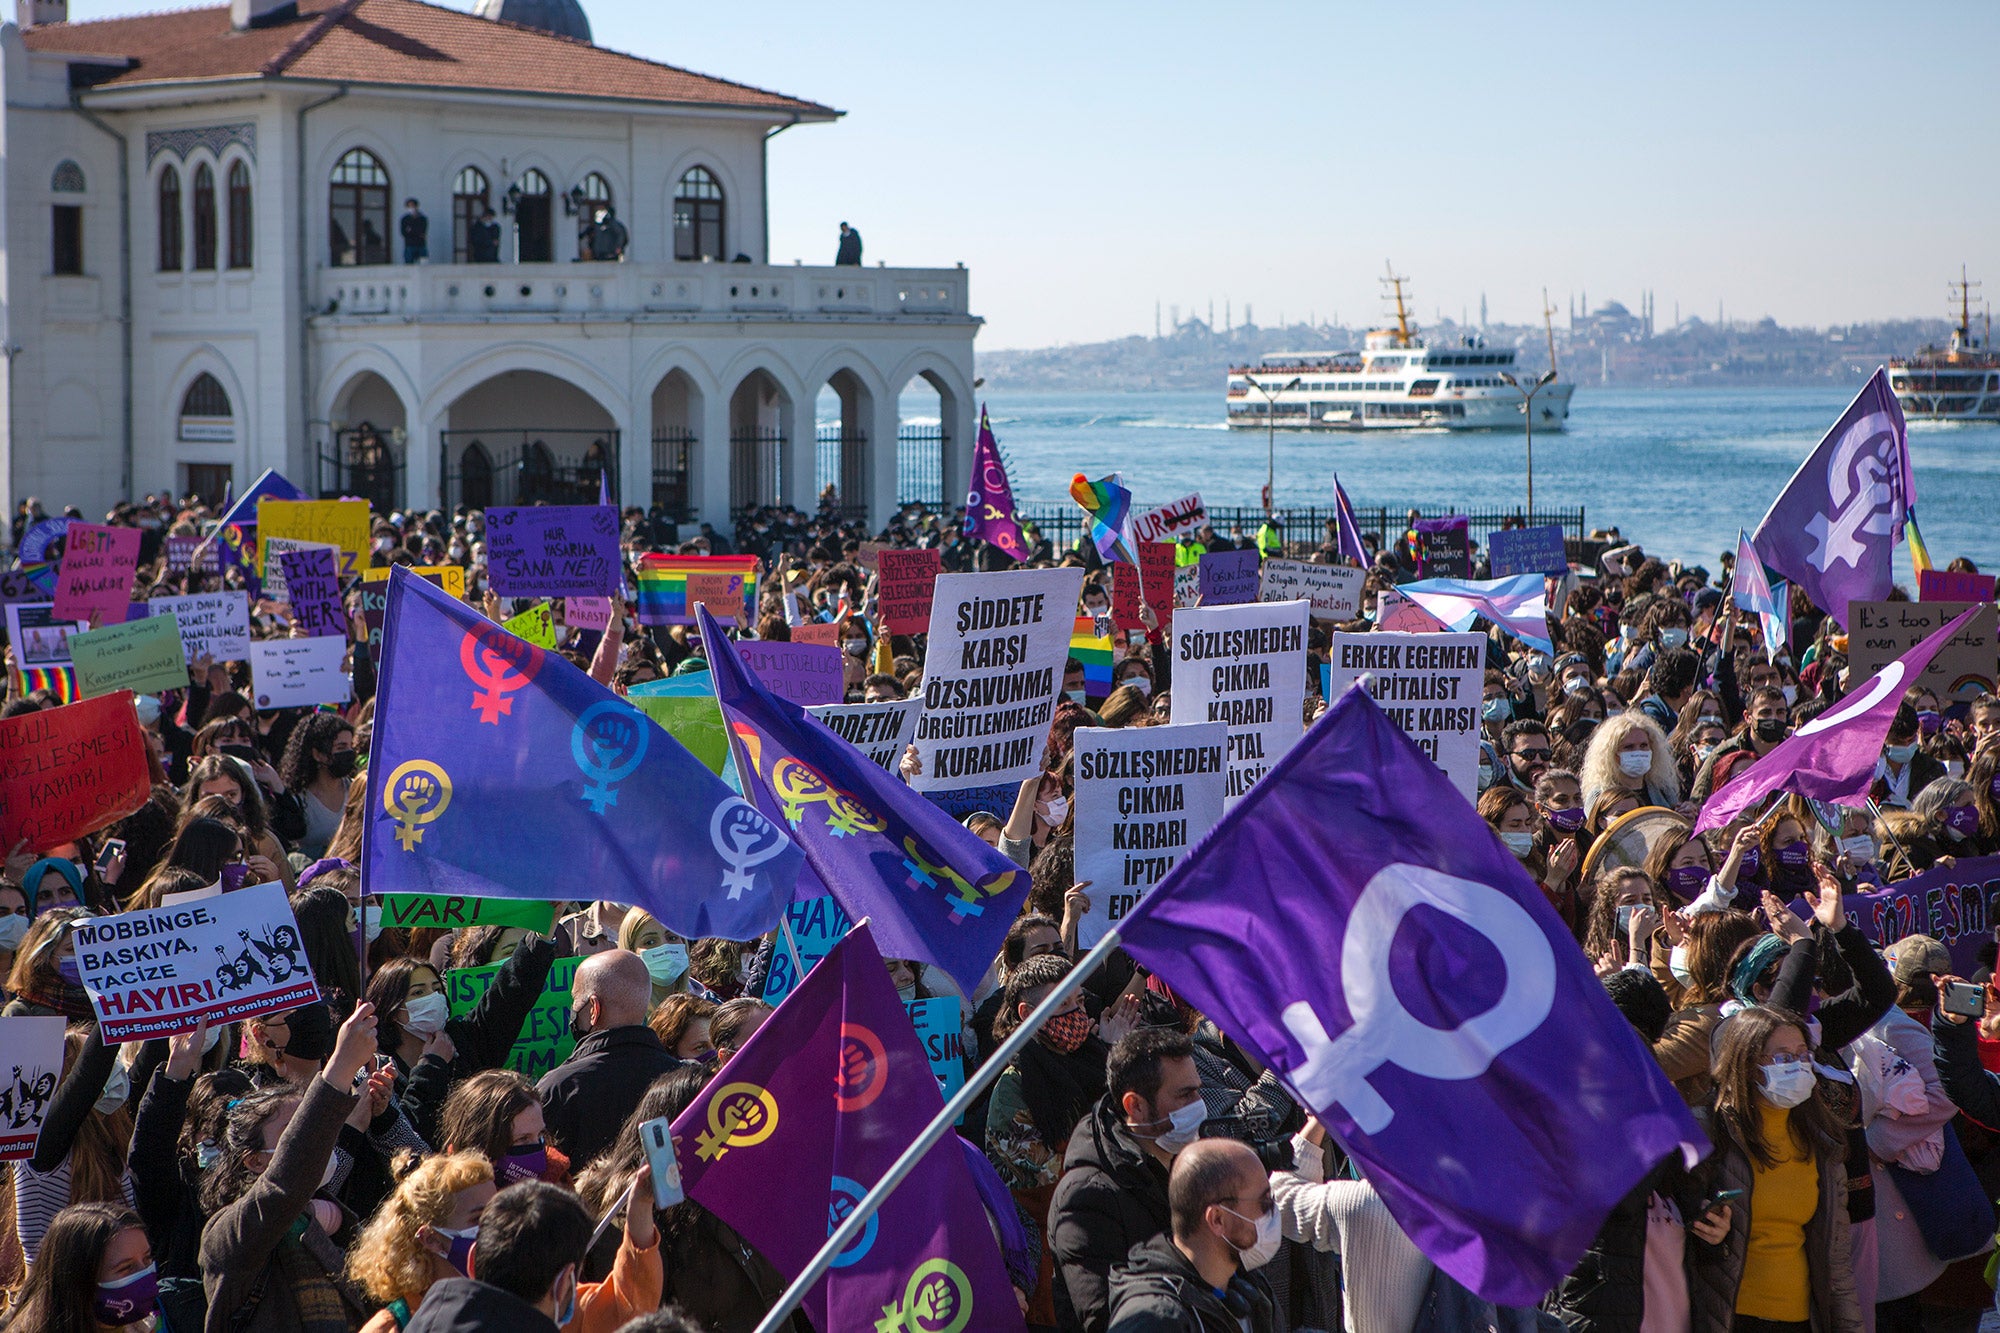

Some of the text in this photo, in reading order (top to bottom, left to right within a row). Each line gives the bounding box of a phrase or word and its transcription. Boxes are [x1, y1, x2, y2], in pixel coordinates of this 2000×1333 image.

[1133, 497, 1205, 543] URDUK
[505, 558, 556, 578] SANA
[956, 592, 1046, 638] ŞİDDETE
[1860, 606, 1889, 630] It's
[1898, 609, 1931, 628] too
[961, 633, 1028, 671] KARŞI
[1179, 624, 1303, 662] SÖZLEŞMEDEN
[1341, 644, 1480, 670] ERKEK EGEMEN
[1865, 637, 1897, 650] even
[924, 667, 1054, 711] ÖZSAVUNMA
[1211, 661, 1271, 698] ÇIKMA
[1354, 672, 1462, 701] APİTALİST
[815, 707, 907, 744] İDDETİN
[917, 697, 1054, 741] ÖRGÜTLENMELERİ
[1207, 696, 1274, 726] KARARI
[1418, 706, 1477, 736] KARŞI
[0, 717, 58, 750] BUL
[1226, 732, 1266, 761] PTAL
[0, 724, 130, 780] ÖZLEŞMESİ
[933, 735, 1035, 779] KURALIM!
[1080, 745, 1222, 783] SÖZLEŞMEDEN
[1117, 783, 1185, 820] ÇIKMA
[1112, 817, 1188, 851] KARARI
[78, 907, 217, 946] MOBBİNGE,
[389, 896, 483, 925] VAR!
[82, 937, 198, 971] BASKIYA,
[88, 963, 178, 991] TACİZE
[97, 979, 217, 1016] HAYIR!
[227, 988, 314, 1015] Komisyonları
